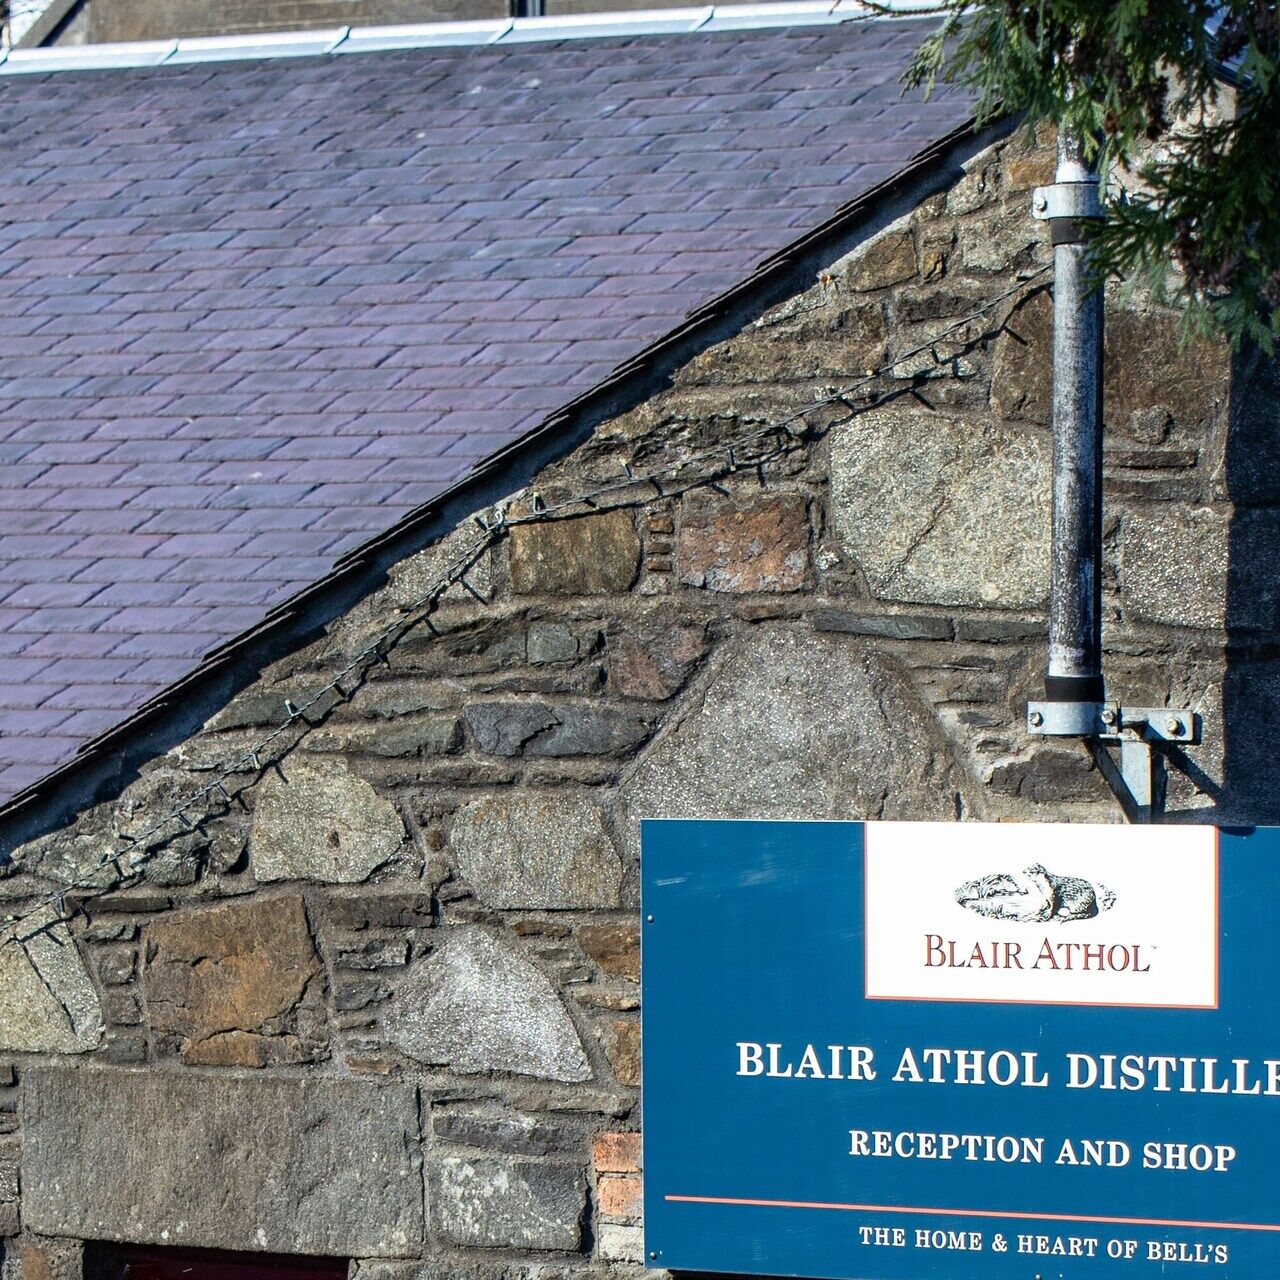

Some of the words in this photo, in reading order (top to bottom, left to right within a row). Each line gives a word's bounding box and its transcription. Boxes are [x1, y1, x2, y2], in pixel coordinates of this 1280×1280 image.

[923, 933, 1024, 970] BLAIR
[736, 1042, 877, 1081] BLAIR
[891, 1047, 1049, 1087] ATHOL
[848, 1130, 1045, 1165] RECEPTION
[1055, 1138, 1131, 1168] AND
[1142, 1142, 1236, 1172] SHOP
[858, 1226, 906, 1247] THE
[914, 1229, 983, 1251] HOME
[991, 1233, 1008, 1253] &
[1017, 1234, 1098, 1257] HEART
[1106, 1239, 1138, 1259] OF
[1146, 1241, 1229, 1264] BELL'S
